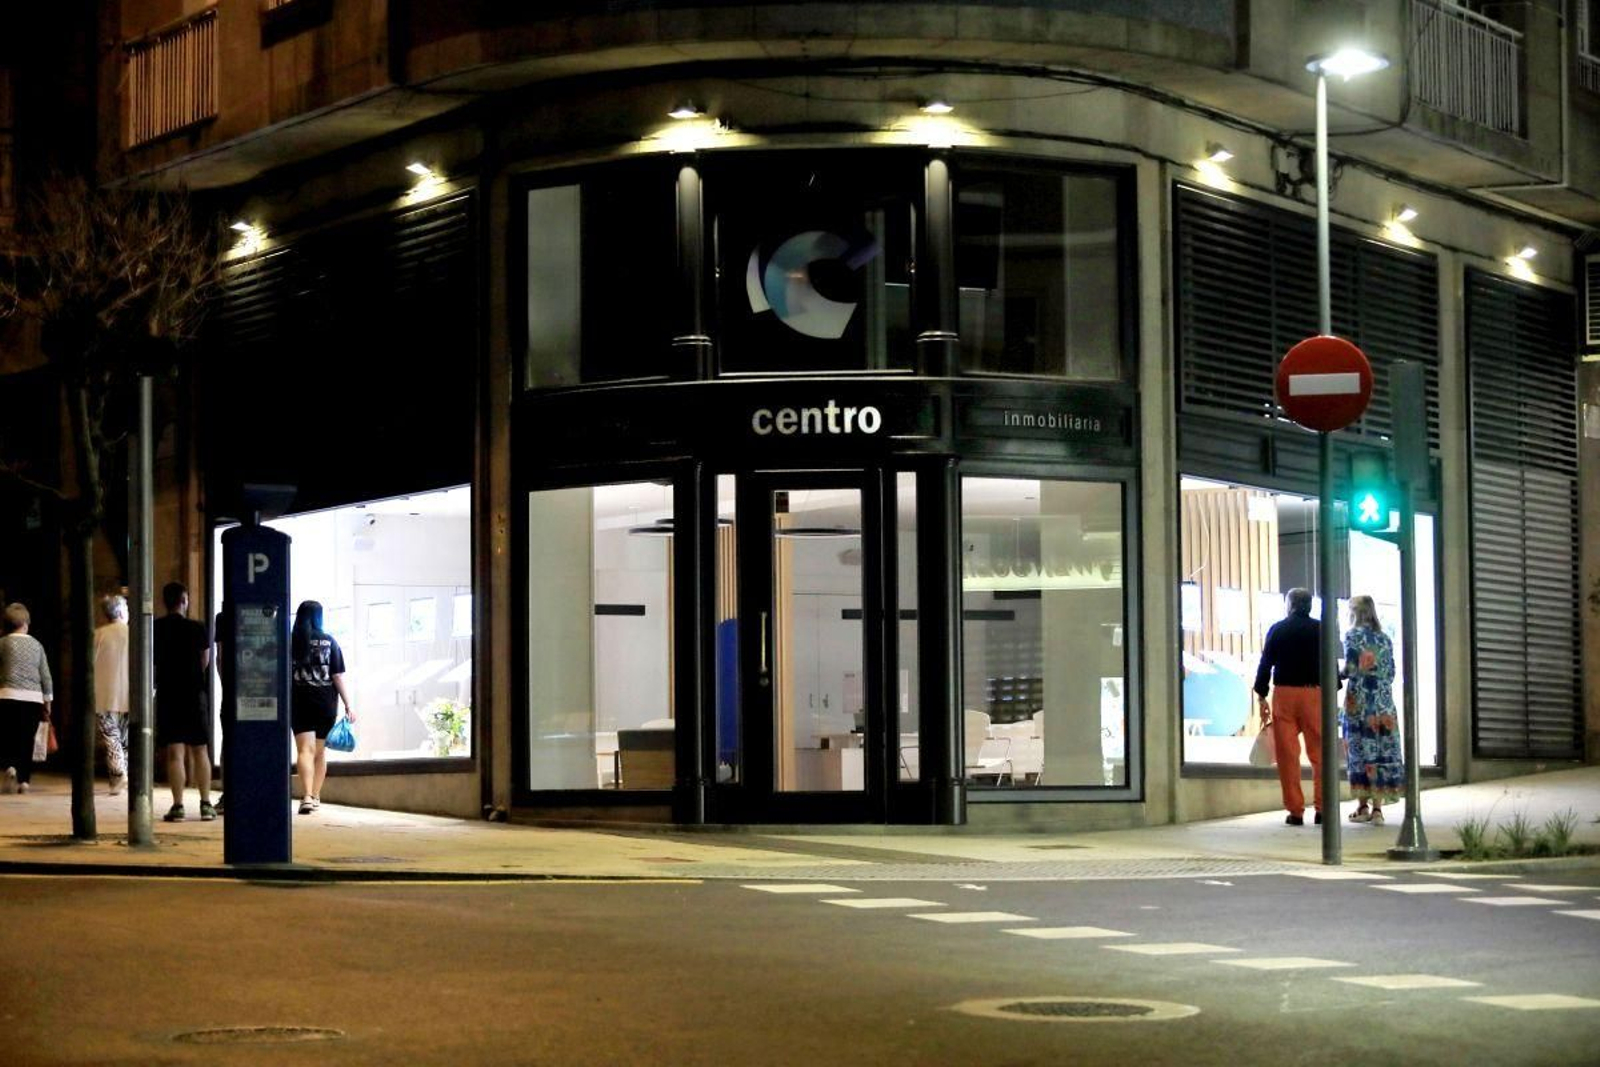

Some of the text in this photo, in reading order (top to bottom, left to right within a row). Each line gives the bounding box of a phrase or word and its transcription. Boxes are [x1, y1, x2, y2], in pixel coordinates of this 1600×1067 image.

[751, 399, 882, 435] centro
[1004, 410, 1101, 432] inmobiliaria
[247, 553, 270, 584] P
